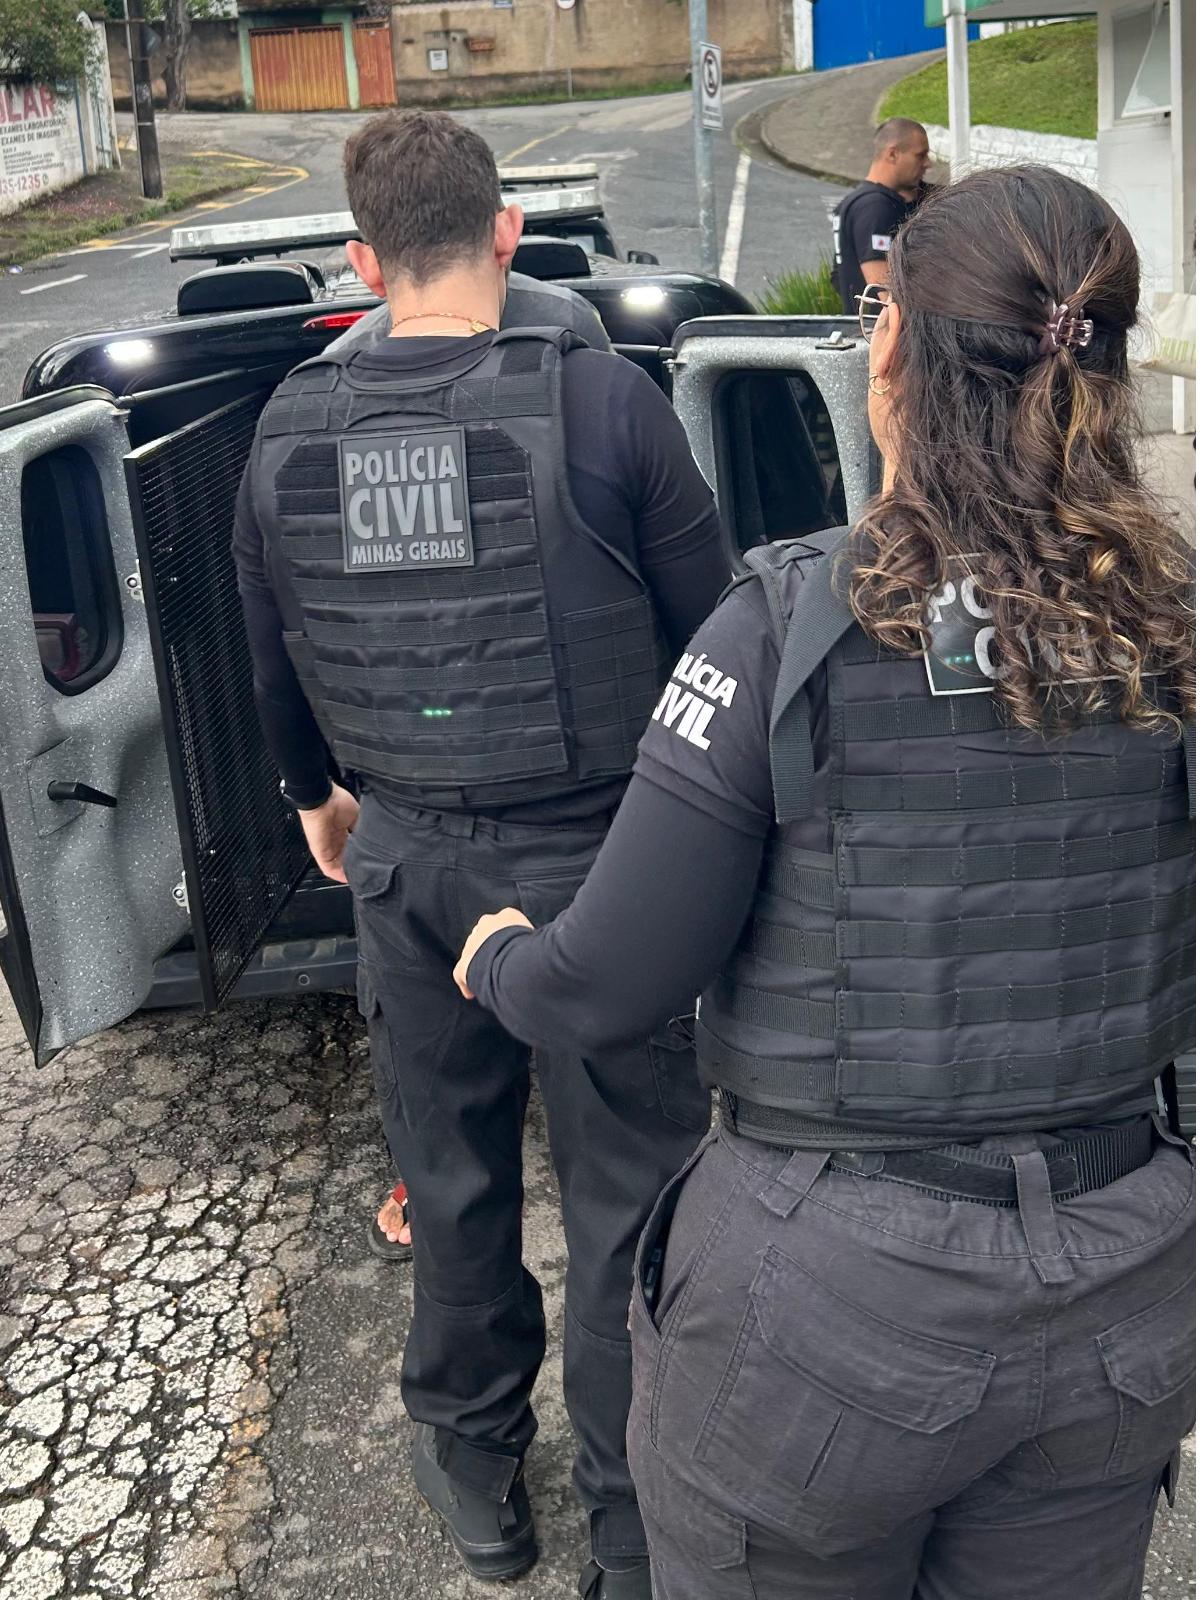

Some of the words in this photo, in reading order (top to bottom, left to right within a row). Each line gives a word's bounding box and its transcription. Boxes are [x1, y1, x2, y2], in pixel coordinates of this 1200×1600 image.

[0, 174, 41, 195] 35-1235
[345, 440, 458, 486] POLÍCIA
[349, 482, 464, 540] CIVIL
[352, 543, 404, 565] MINAS
[409, 539, 466, 561] GERAIS
[672, 652, 738, 708] OLÍCIA
[651, 681, 716, 751] IVIL
